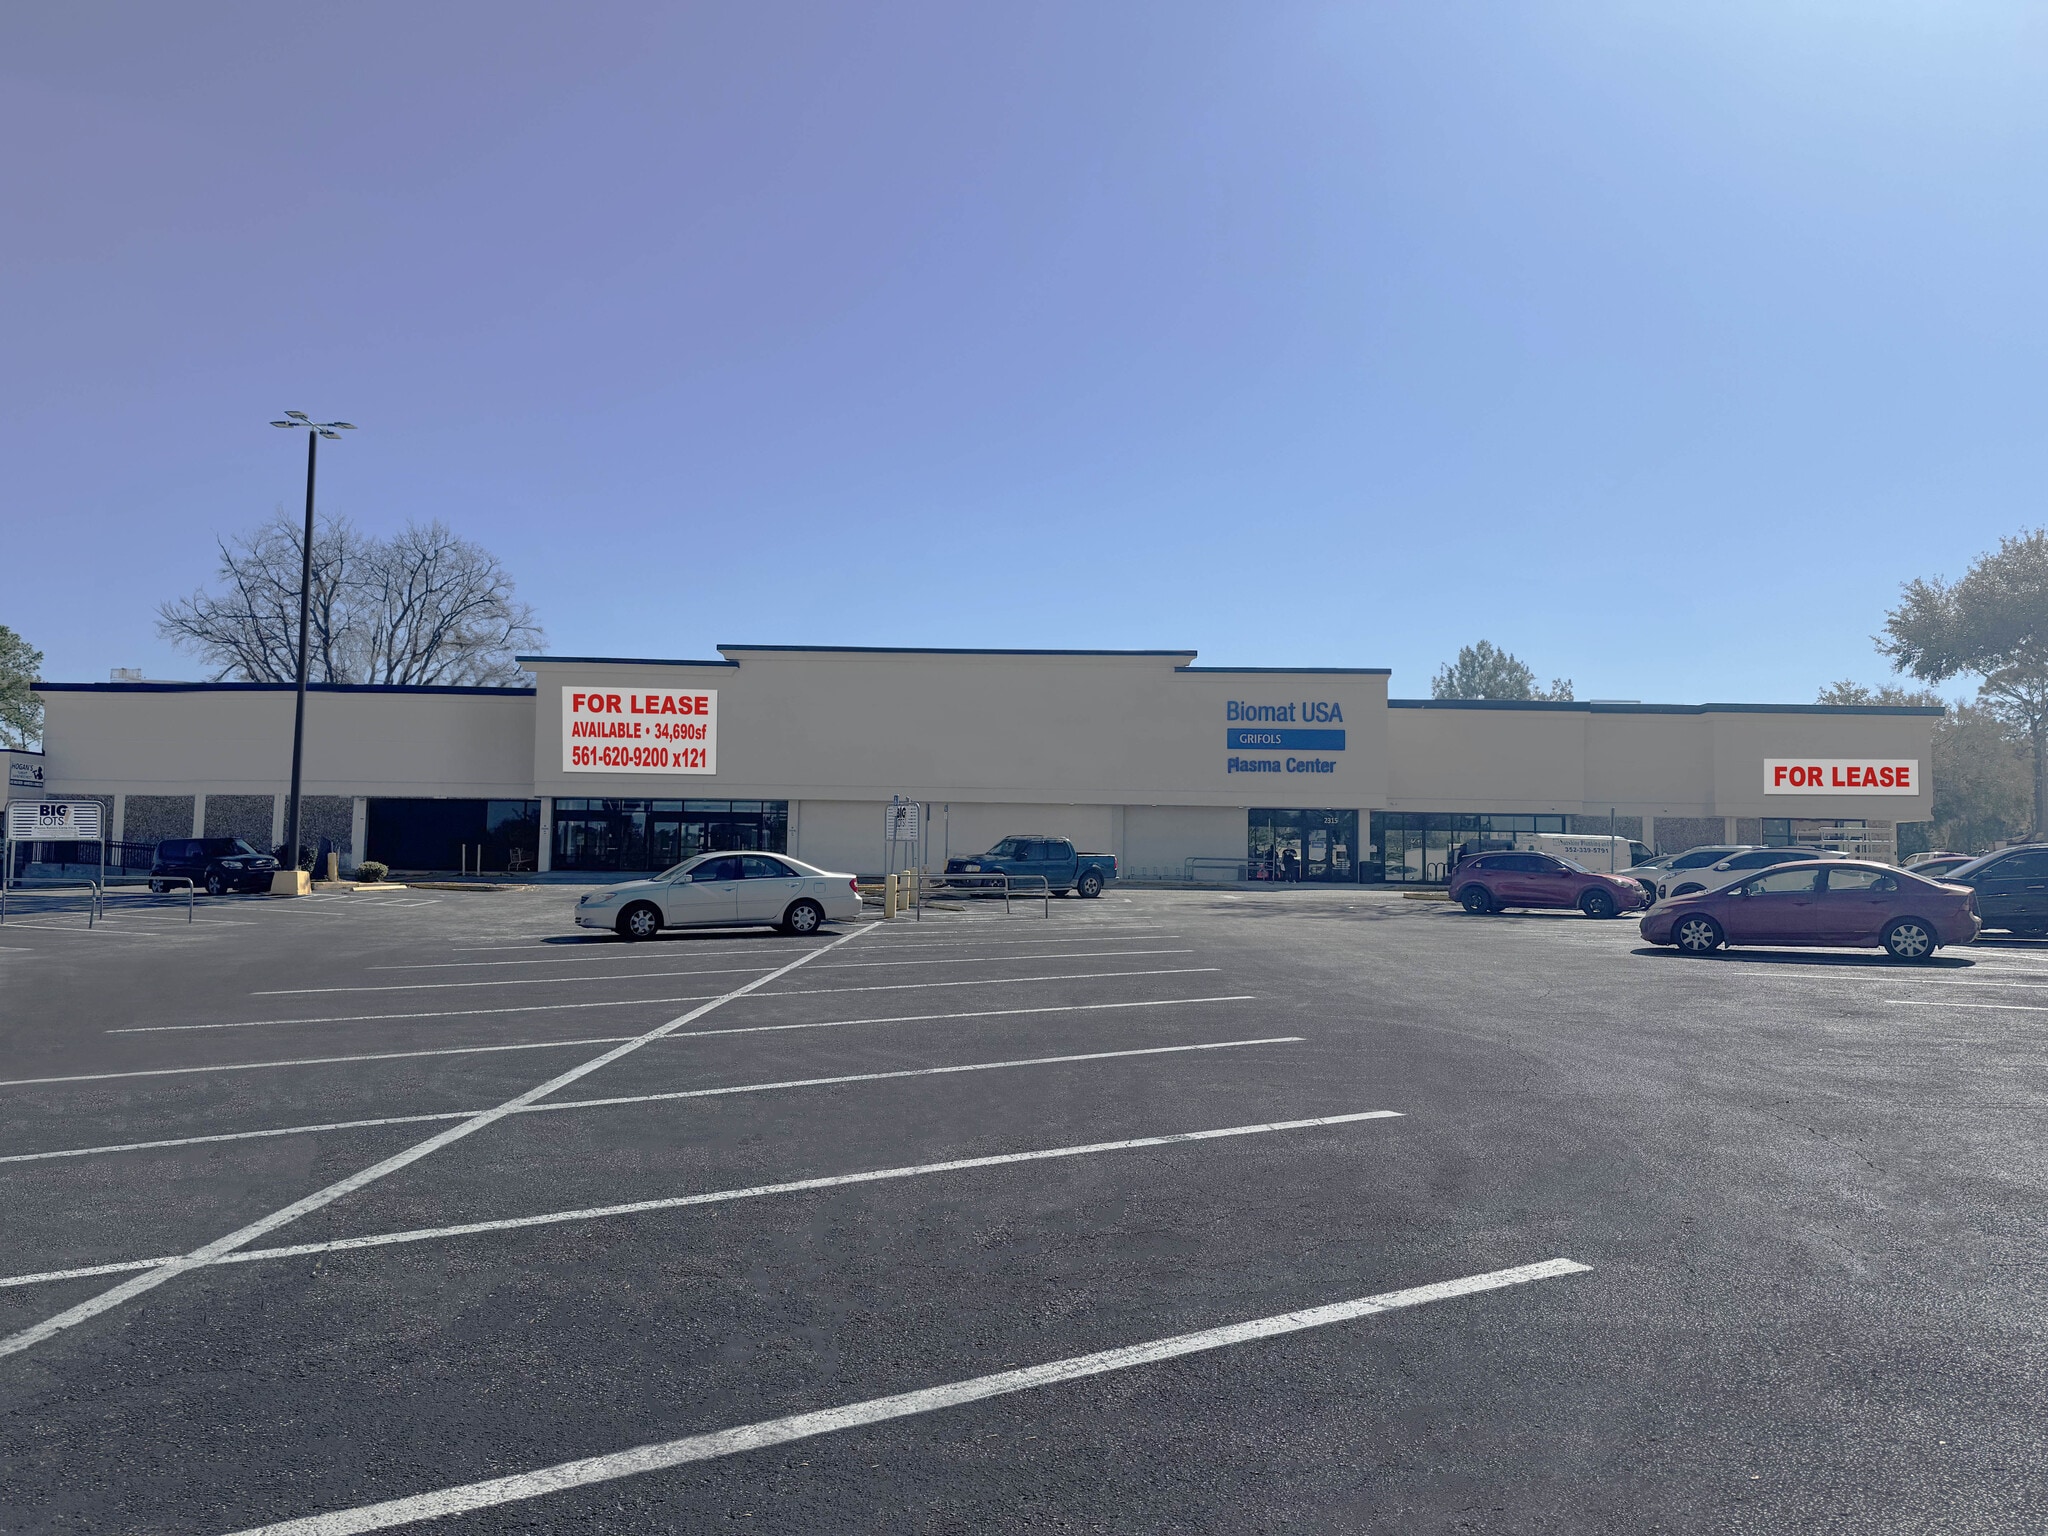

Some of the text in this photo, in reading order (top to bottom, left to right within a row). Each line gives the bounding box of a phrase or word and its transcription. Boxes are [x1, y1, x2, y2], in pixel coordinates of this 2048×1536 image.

[572, 693, 709, 715] FOR LEASE
[1226, 700, 1344, 722] Biomat USA
[571, 721, 707, 743] AVAILABLE 34,690sf
[1239, 733, 1282, 744] GRIFOLS
[572, 745, 706, 768] 561-620-9200 x121
[1227, 756, 1337, 774] Plasma Center
[1774, 766, 1910, 787] FOR LEASE
[39, 804, 69, 817] BIG
